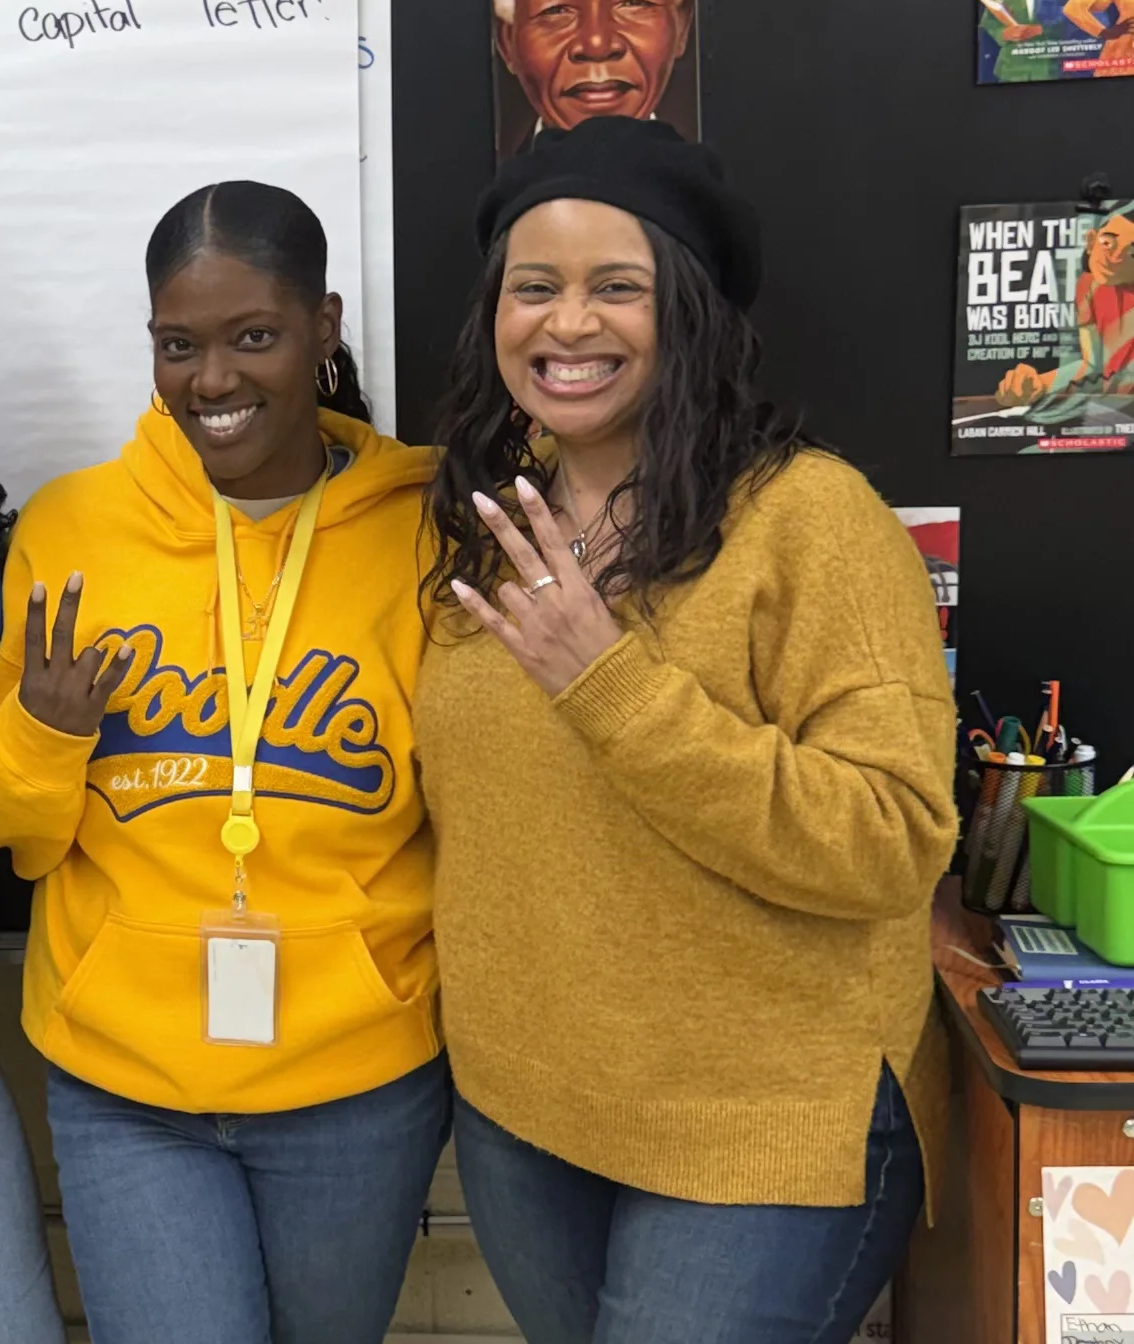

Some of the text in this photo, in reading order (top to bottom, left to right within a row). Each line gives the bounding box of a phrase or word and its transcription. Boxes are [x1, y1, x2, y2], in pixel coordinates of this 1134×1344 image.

[969, 216, 1094, 251] WHEN THE
[967, 248, 1085, 306] BEAT
[966, 302, 1076, 332] WAS BORN
[1066, 1317, 1123, 1333] Ethan
